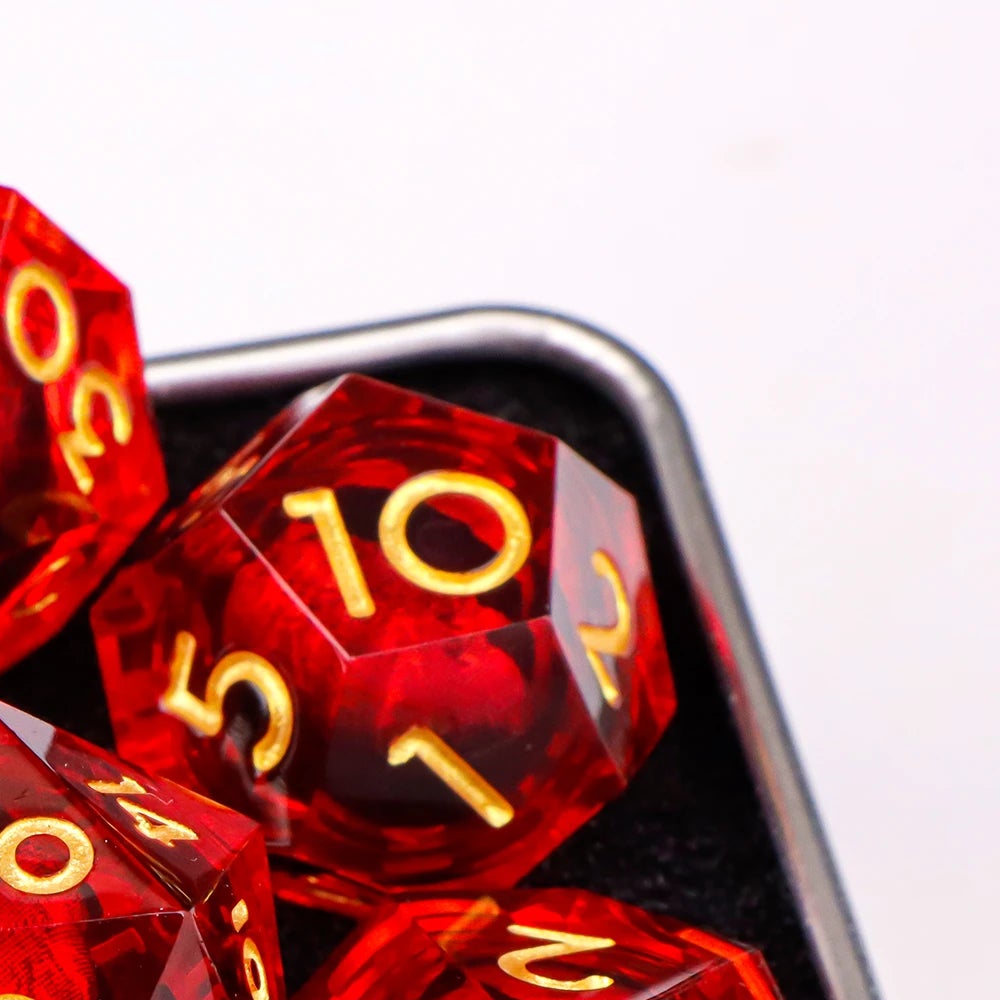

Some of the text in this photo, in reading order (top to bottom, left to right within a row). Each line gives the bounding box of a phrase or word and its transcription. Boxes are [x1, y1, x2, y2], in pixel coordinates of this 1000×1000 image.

[5, 263, 132, 494] 30
[283, 471, 531, 618] 10
[577, 549, 633, 707] 2
[160, 631, 293, 773] 5
[388, 727, 514, 828] 1
